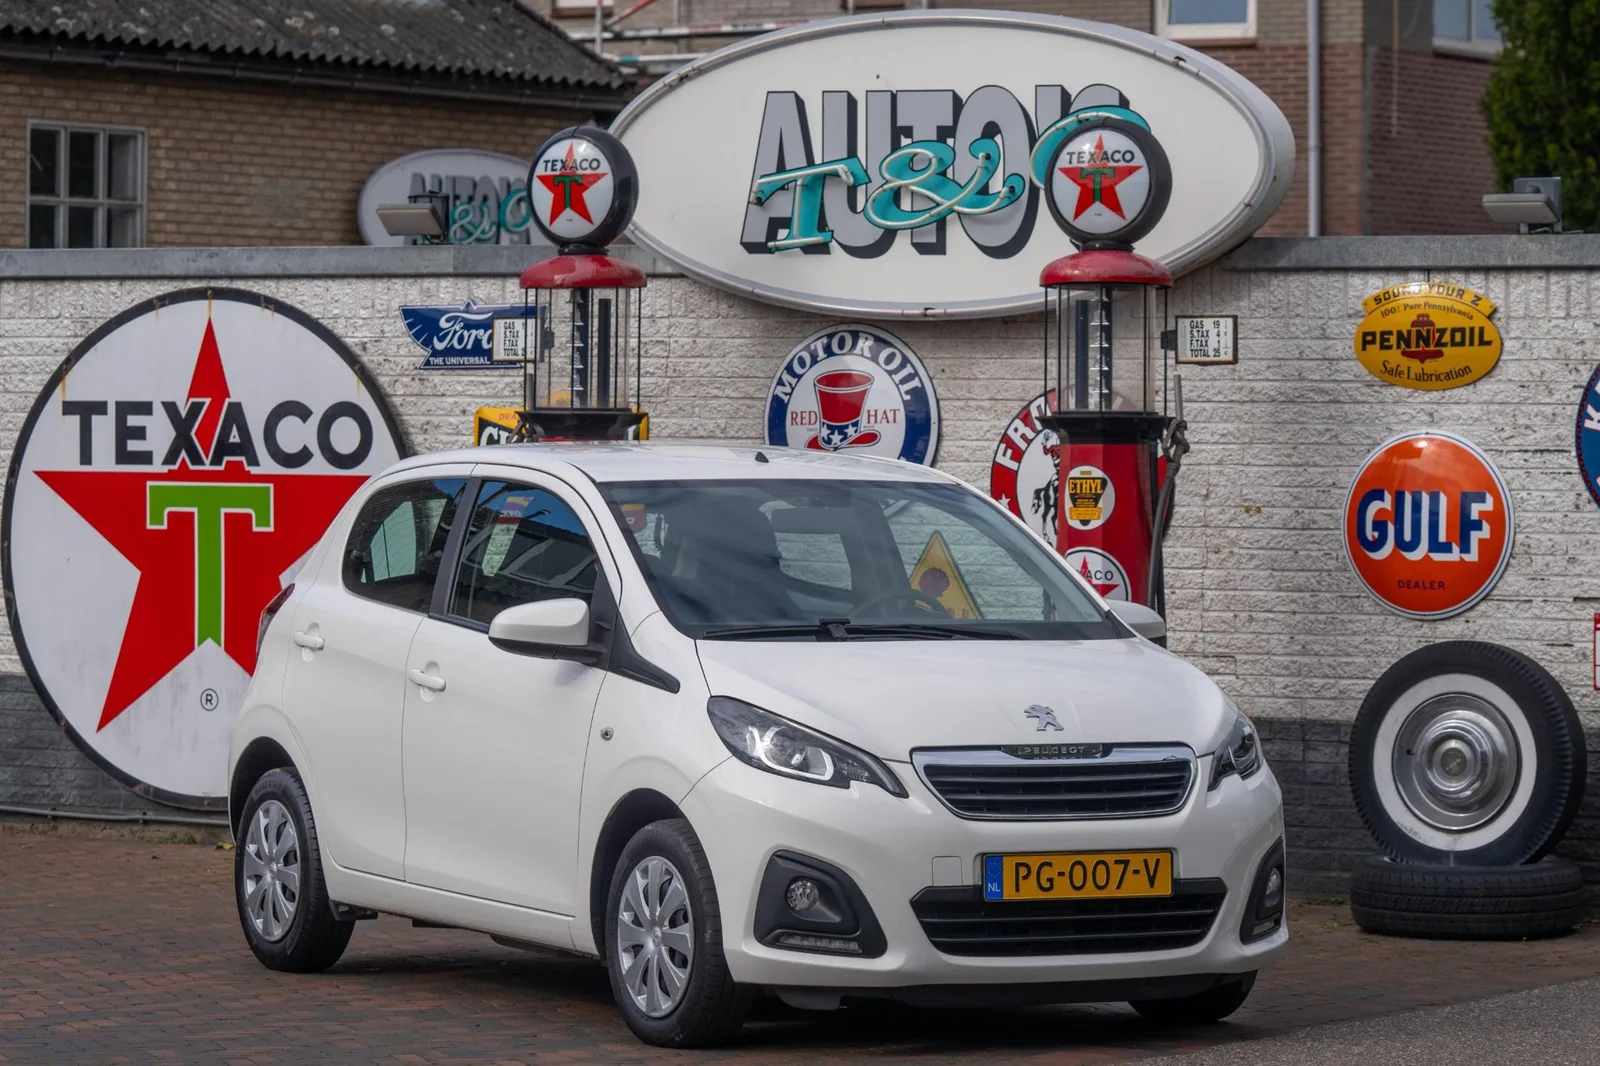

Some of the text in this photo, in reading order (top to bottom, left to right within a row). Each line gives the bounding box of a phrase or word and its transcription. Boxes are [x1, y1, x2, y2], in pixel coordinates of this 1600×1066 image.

[1066, 149, 1135, 165] TEXACO
[543, 158, 601, 172] TEXACO
[1373, 284, 1483, 307] SOUND YOUR Z
[1403, 302, 1422, 312] Pure
[1423, 301, 1474, 320] Pennsylvania
[503, 321, 515, 330] GAS
[1189, 320, 1204, 329] GAS
[1213, 320, 1220, 329] 19
[503, 331, 519, 339] S.TAX
[1190, 330, 1210, 338] S.TAX
[1216, 330, 1220, 338] 4
[1361, 326, 1494, 351] PENNZOIL
[503, 340, 519, 348] F.TAX
[1189, 339, 1209, 348] F.TAX
[503, 348, 519, 356] TOTAL
[1190, 348, 1211, 357] TOTAL
[1213, 348, 1221, 357] 25
[429, 357, 444, 365] THE
[445, 356, 491, 365] UNIVERSAL
[774, 331, 922, 404] MOTOR OIL
[1380, 360, 1473, 382] Safe Lubrication
[790, 408, 900, 426] RED HAT
[62, 399, 374, 471] TEXACO
[1069, 479, 1104, 494] ETHYL
[1356, 488, 1494, 562] GULF
[1397, 580, 1446, 590] DEALER
[1023, 746, 1086, 755] PEUGEOT
[987, 858, 1161, 893] NL PG-007-V
